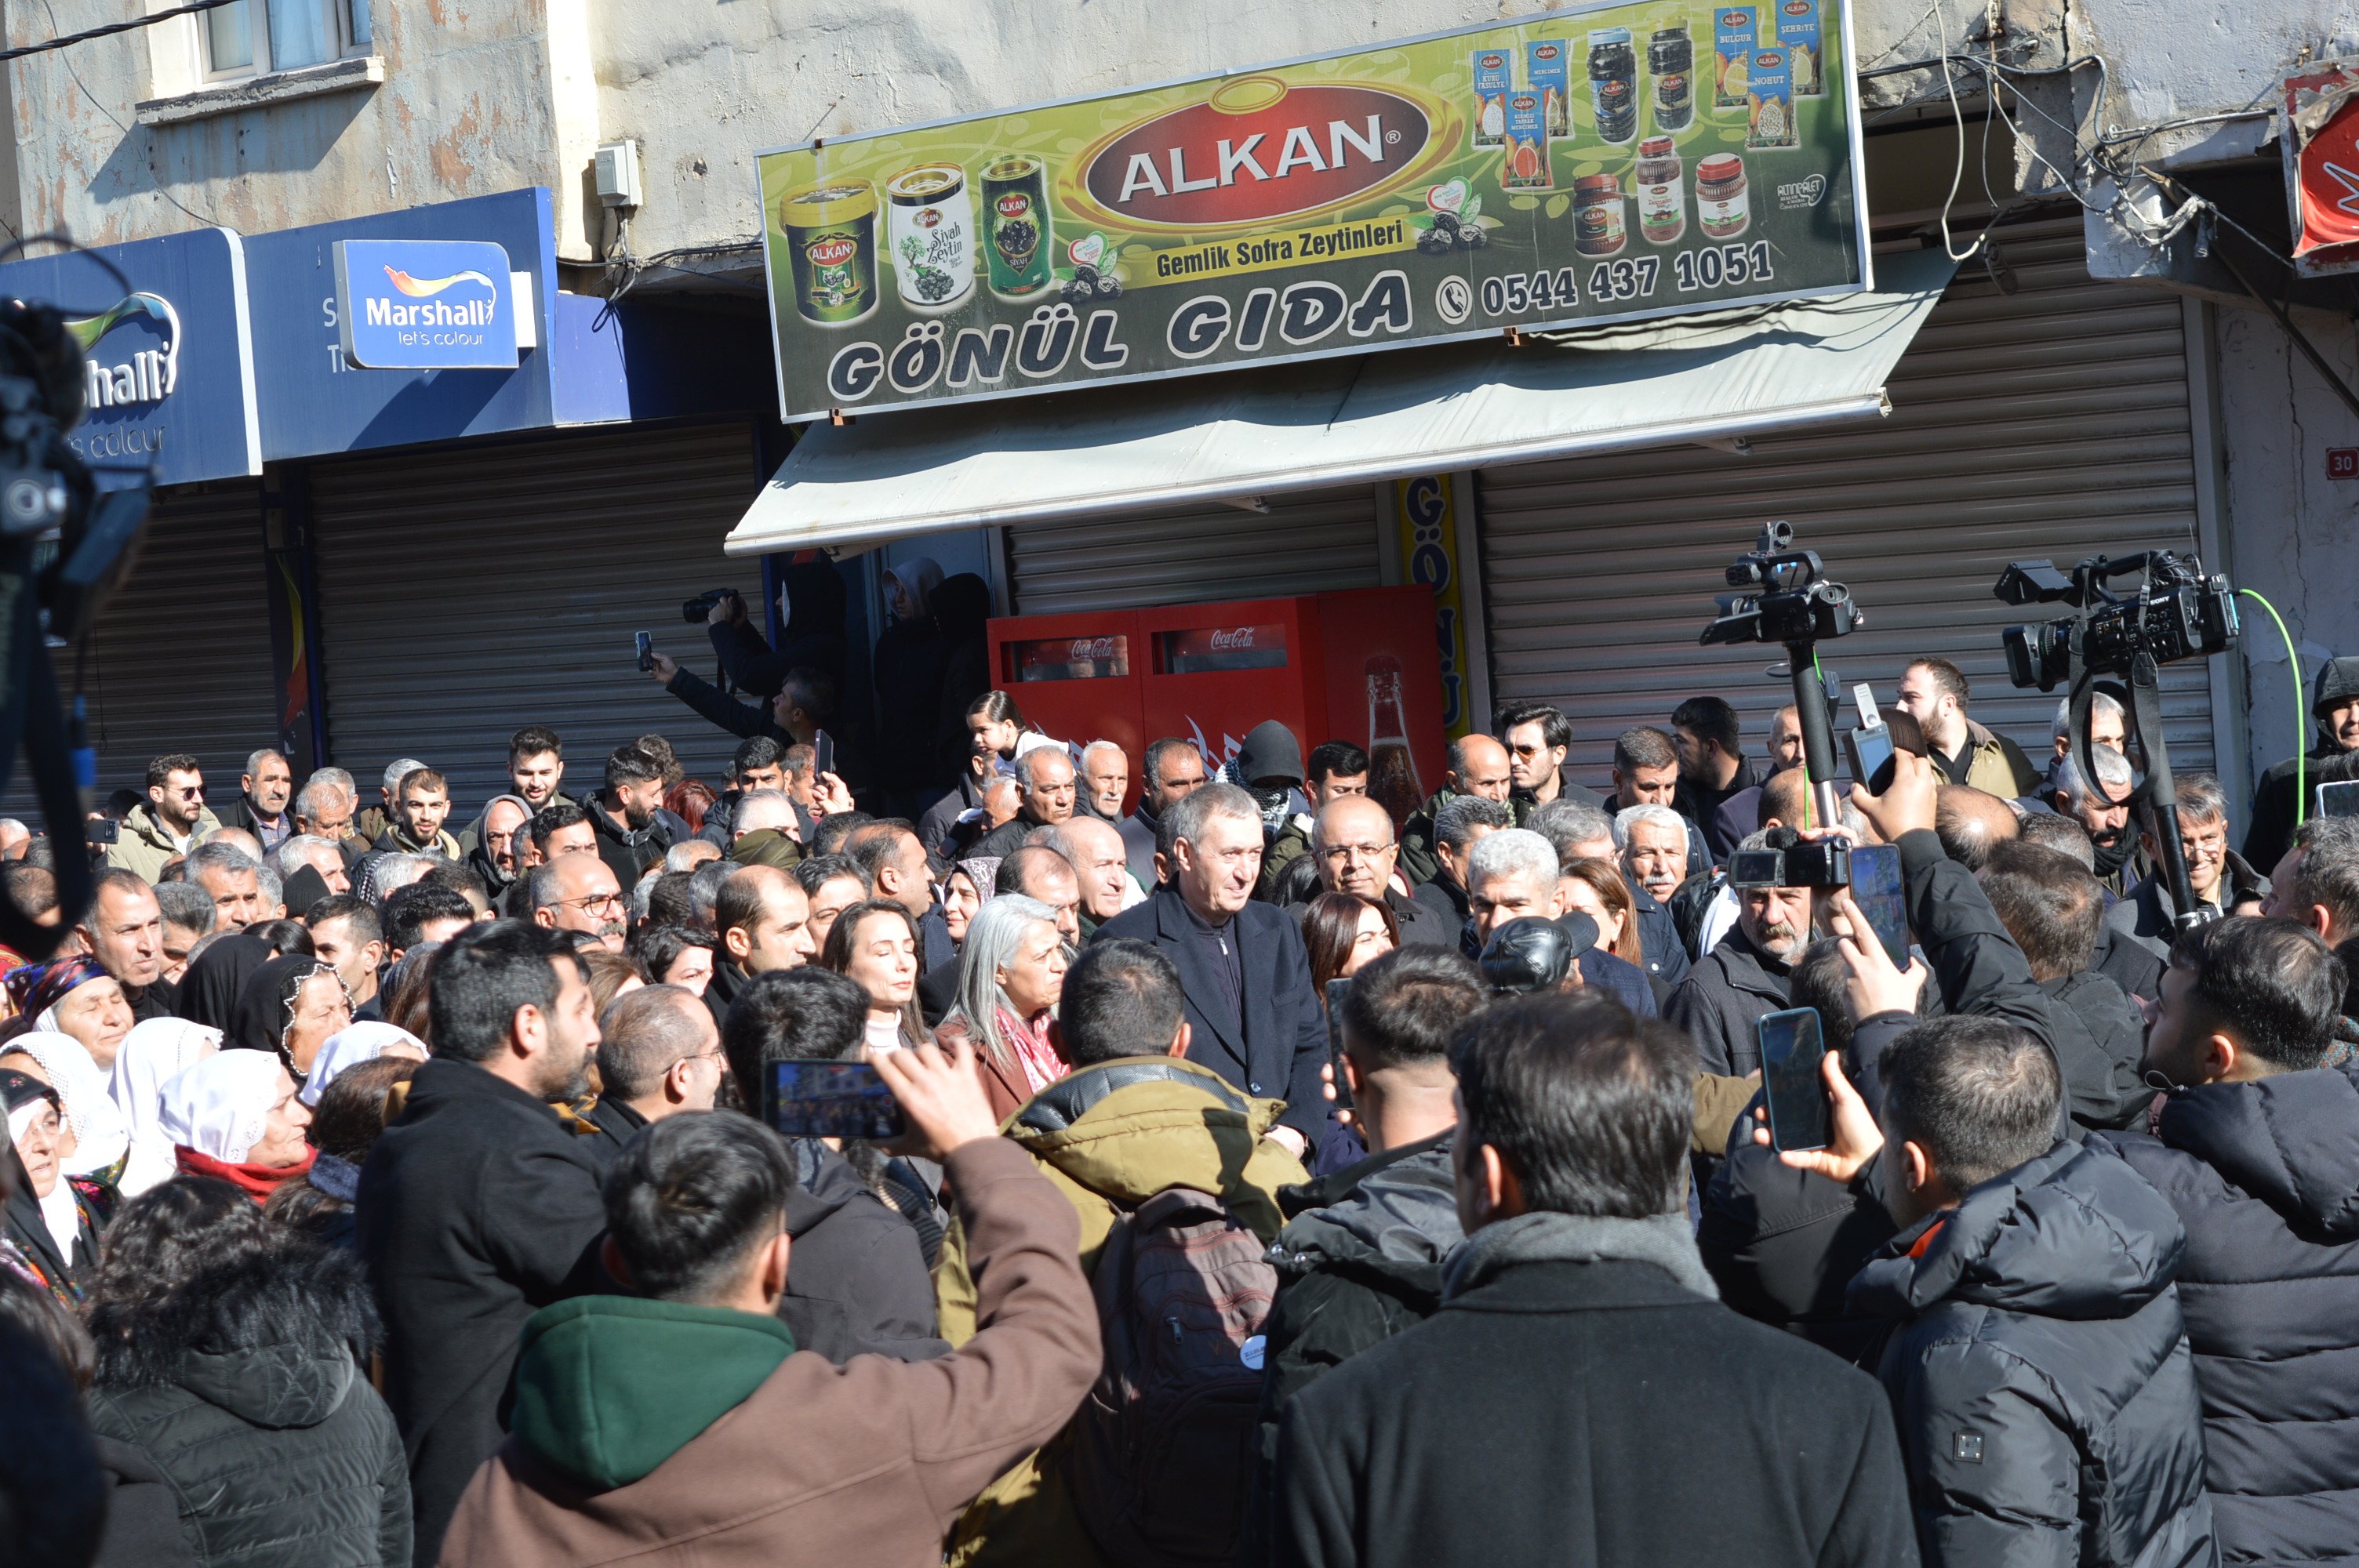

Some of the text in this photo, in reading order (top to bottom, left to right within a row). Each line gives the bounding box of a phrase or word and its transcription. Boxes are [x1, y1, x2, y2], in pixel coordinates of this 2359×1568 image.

[1720, 34, 1752, 44] BULGUR
[1605, 84, 1625, 93] ALKAN
[1663, 78, 1683, 87] ALKAN
[1754, 76, 1785, 85] NOHUT
[1118, 114, 1386, 203] ALKAN
[999, 198, 1027, 212] ALKAN
[916, 213, 939, 224] ALKAN
[1584, 211, 1605, 220] ALKAN
[930, 221, 961, 251] Siyah
[812, 243, 850, 260] ALKAN
[927, 241, 963, 264] Zeytin
[1156, 220, 1404, 278] Gemlik Sofra Zeytinleri
[1481, 239, 1774, 317] 0544 437 1051
[365, 297, 485, 326] Marshall
[398, 330, 483, 346] let's colour
[826, 270, 1414, 401] GÖNÜL GIDA
[90, 424, 165, 459] colour
[2333, 456, 2352, 470] 30
[2150, 595, 2170, 605] SONY
